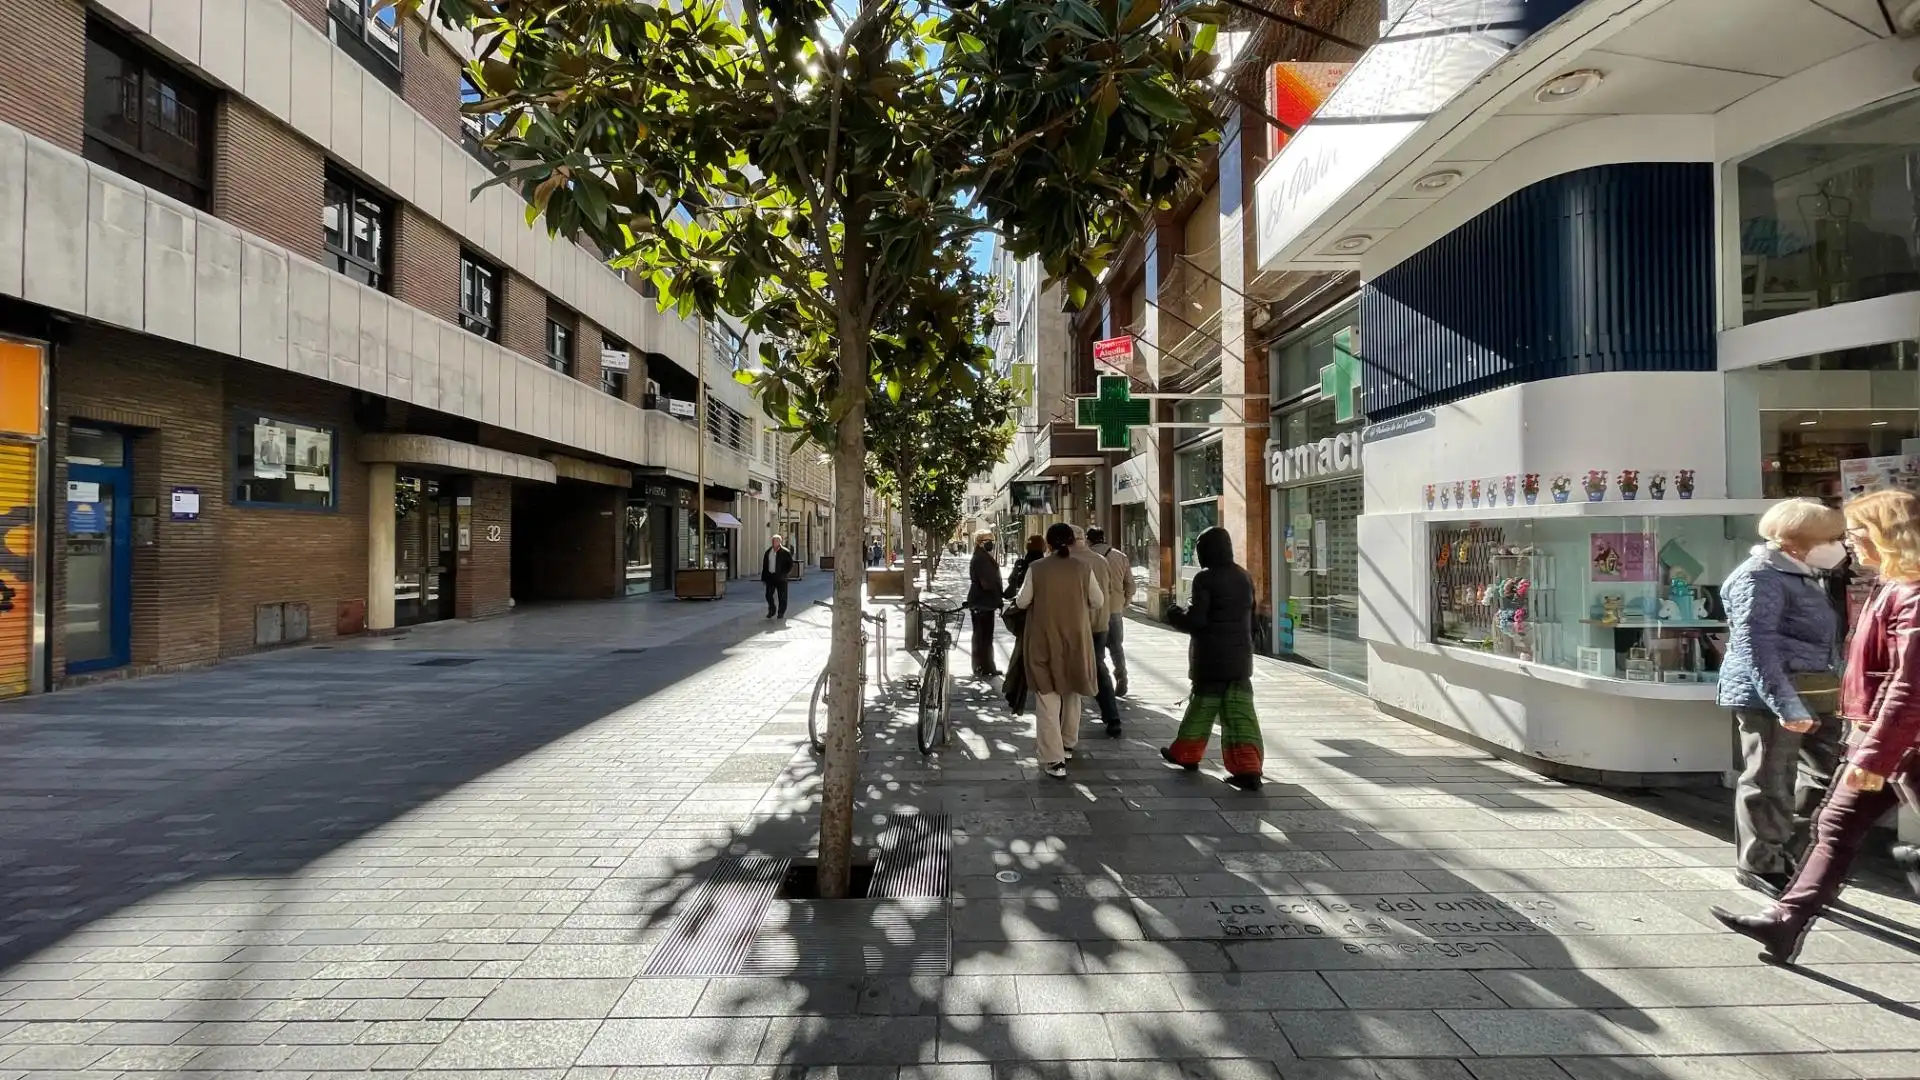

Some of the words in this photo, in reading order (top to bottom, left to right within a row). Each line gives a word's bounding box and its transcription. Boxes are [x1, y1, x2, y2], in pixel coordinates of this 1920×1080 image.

[1264, 431, 1365, 486] farmaci
[486, 525, 501, 542] 32
[1209, 900, 1266, 915] Las
[1375, 897, 1427, 913] del
[1216, 919, 1324, 937] barrio
[1342, 941, 1503, 958] emergen
